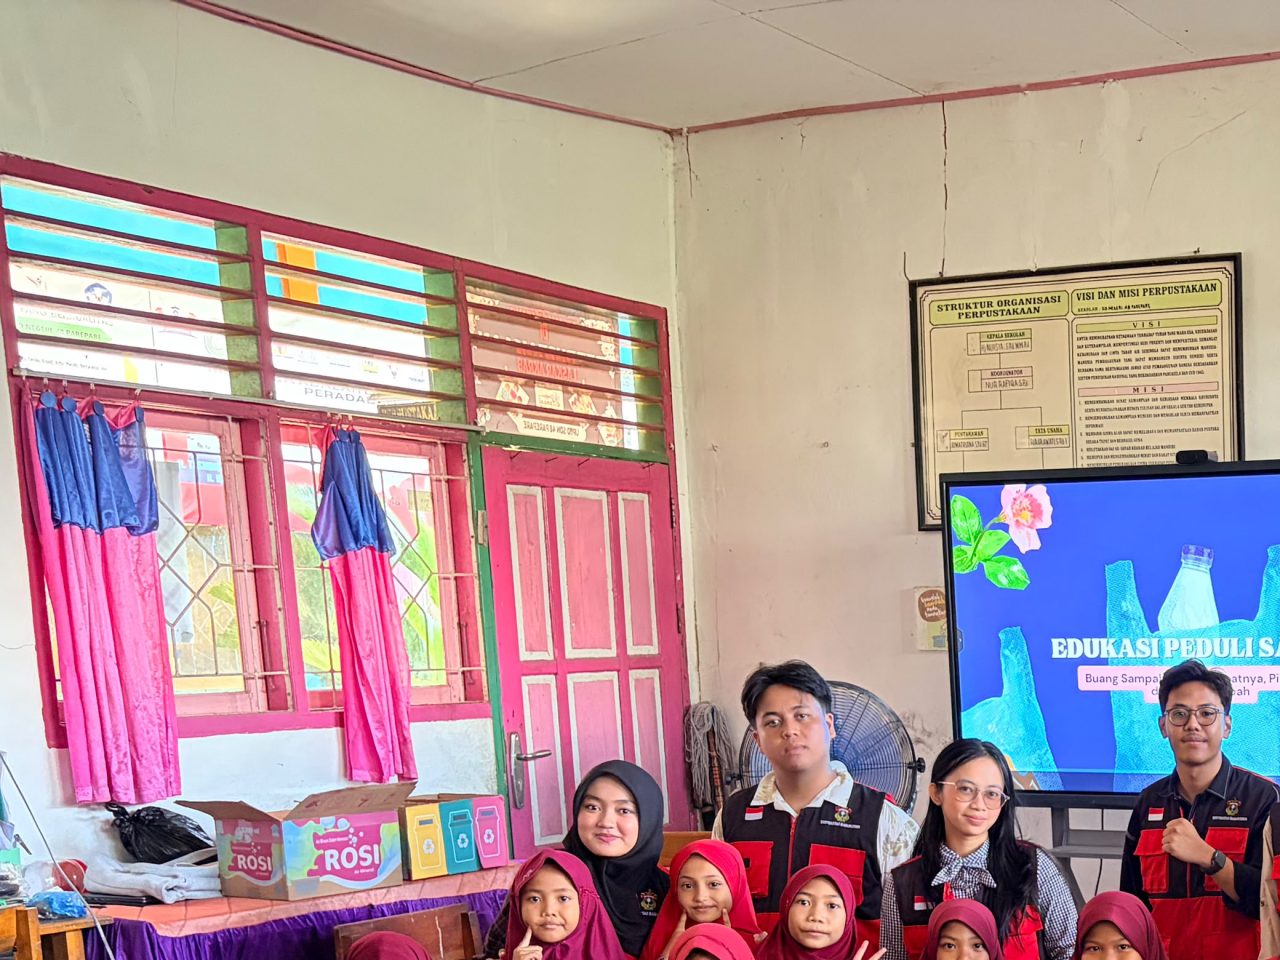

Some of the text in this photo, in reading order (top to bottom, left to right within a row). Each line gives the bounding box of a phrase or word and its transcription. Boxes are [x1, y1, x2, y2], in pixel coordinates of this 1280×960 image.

[1076, 283, 1217, 301] VISI DAN MISI PERPUSTAKAAN
[937, 295, 1062, 312] STRUKTUR ORGANISASI
[958, 306, 1041, 320] PERPUSTAKAAN
[1051, 637, 1161, 660] EDUKASI
[1165, 636, 1256, 659] PEDULI
[1085, 673, 1119, 686] Buang
[1231, 673, 1266, 686] atnya,
[237, 854, 272, 871] ROSI
[324, 844, 380, 871] ROSI
